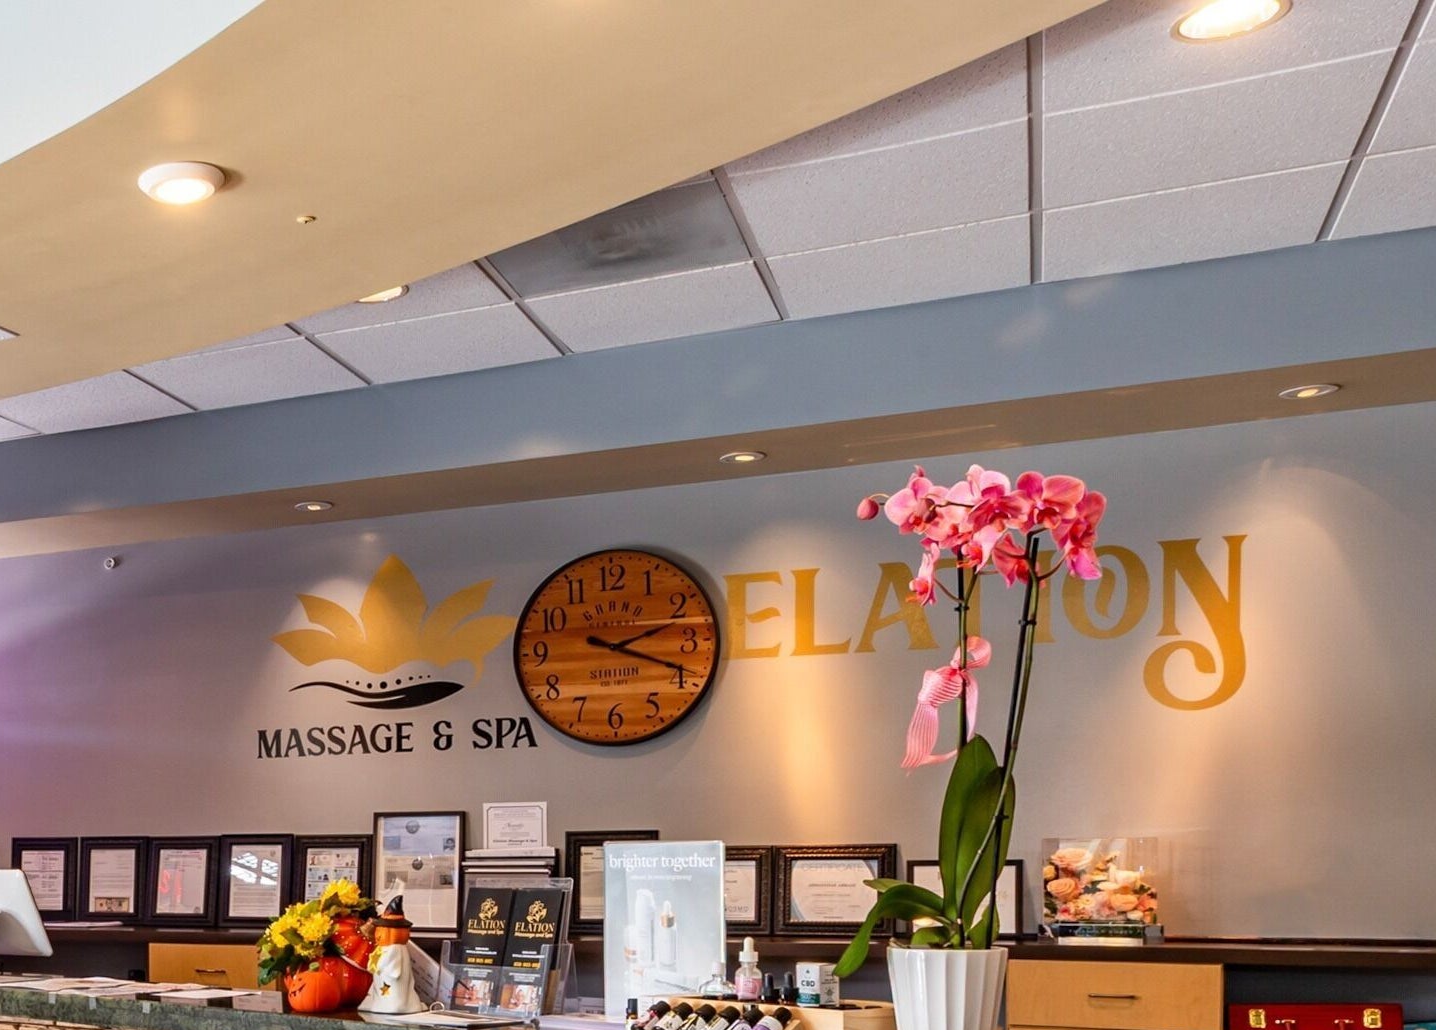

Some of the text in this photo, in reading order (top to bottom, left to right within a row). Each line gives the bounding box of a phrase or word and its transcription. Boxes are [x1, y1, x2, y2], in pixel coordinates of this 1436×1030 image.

[568, 578, 584, 604] 11
[600, 565, 626, 591] 12
[643, 570, 653, 596] 1
[583, 600, 644, 622] GRAND
[669, 592, 687, 619] 2
[542, 607, 567, 633] 10
[533, 640, 548, 667] 9
[680, 627, 698, 655] 3
[590, 666, 639, 680] STATION
[669, 665, 688, 689] 4
[545, 674, 560, 700] 8
[572, 696, 587, 723] 7
[608, 703, 623, 730] 6
[645, 692, 660, 719] 5
[256, 716, 538, 759] MASSAGE & SPA
[609, 852, 716, 872] brighter together
[468, 919, 505, 930] ELATION
[514, 922, 555, 933] ELATION
